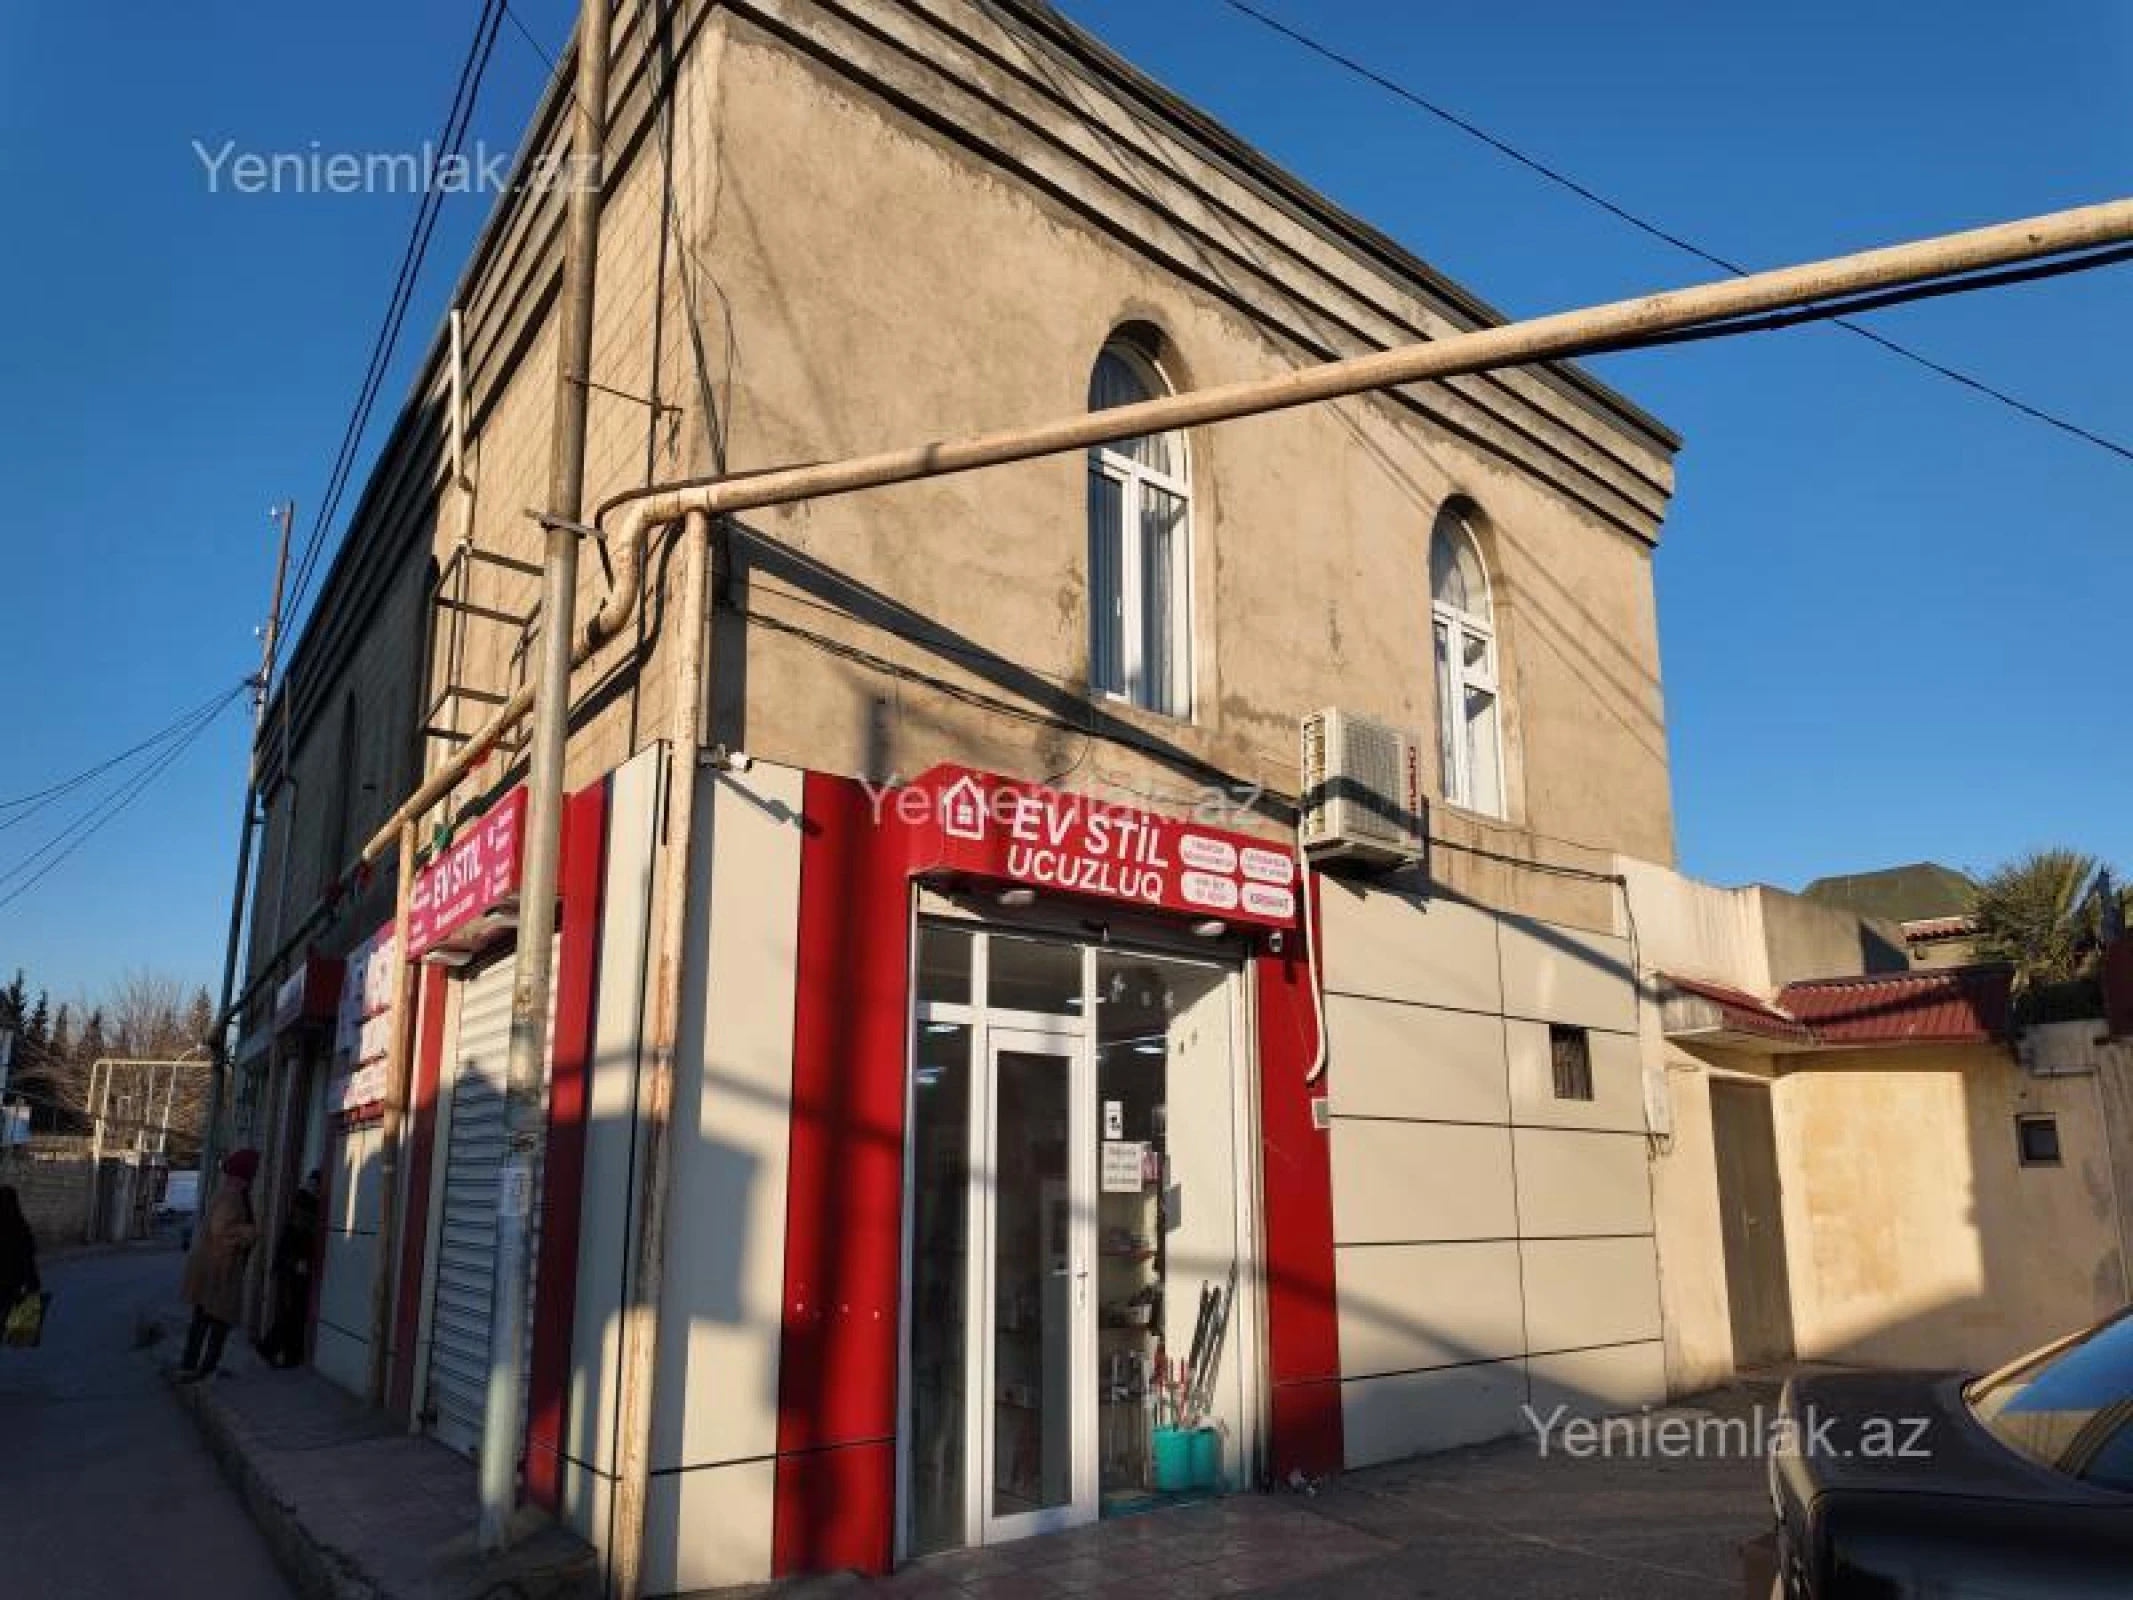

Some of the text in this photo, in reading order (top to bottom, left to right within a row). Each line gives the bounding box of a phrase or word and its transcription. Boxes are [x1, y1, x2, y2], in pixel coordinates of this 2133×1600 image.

[1012, 798, 1076, 846] EV
[1085, 815, 1169, 868] STİL
[1007, 845, 1164, 905] UCUZLUQ
